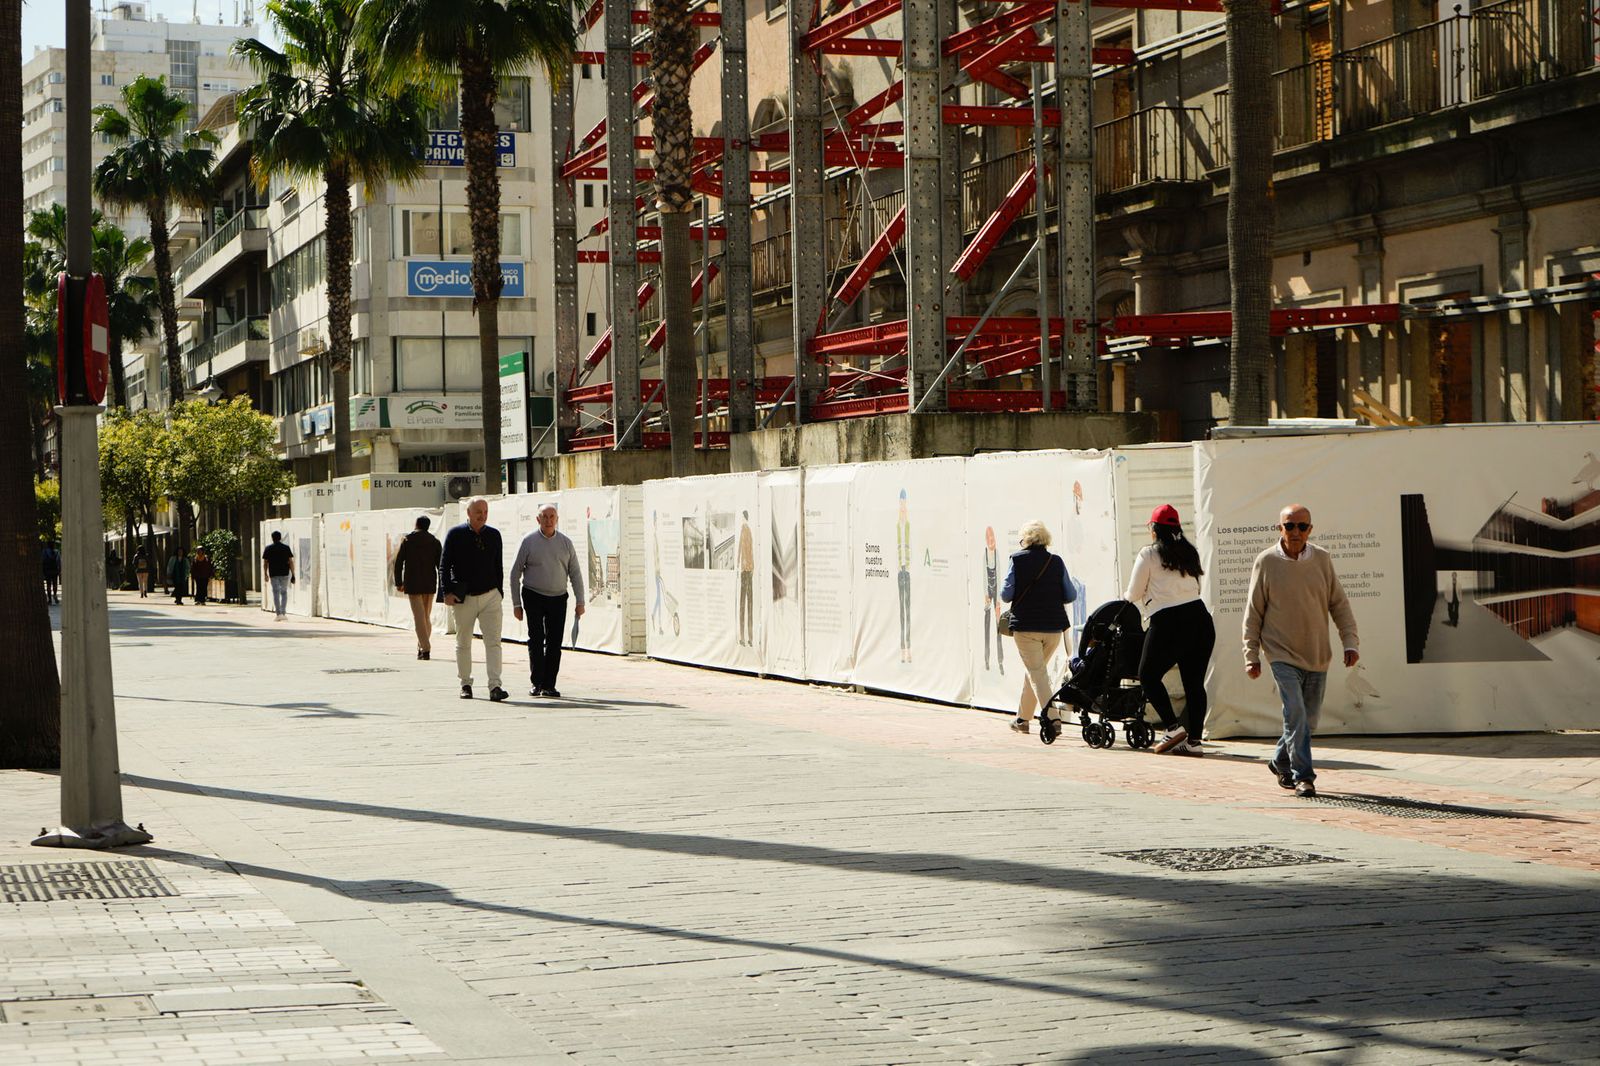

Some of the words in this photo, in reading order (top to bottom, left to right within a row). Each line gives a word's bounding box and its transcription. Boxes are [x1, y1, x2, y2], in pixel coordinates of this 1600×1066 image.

[424, 147, 465, 160] PRIVA
[419, 269, 519, 286] mediom
[416, 416, 444, 424] Puente
[374, 480, 383, 488] EL
[386, 480, 412, 488] PICOTE
[316, 489, 325, 497] EL
[1232, 525, 1269, 534] espacios
[1233, 538, 1264, 547] lugares
[1318, 533, 1363, 541] distribuyen
[1365, 531, 1375, 539] de
[865, 542, 880, 553] Somos
[1218, 547, 1241, 555] forma
[1348, 541, 1380, 549] fachada
[865, 555, 882, 565] nuestro
[1218, 556, 1253, 565] principal
[865, 567, 889, 579] patrimonio
[1219, 566, 1253, 574] interiore
[1338, 572, 1358, 580] estar
[1361, 571, 1370, 579] de
